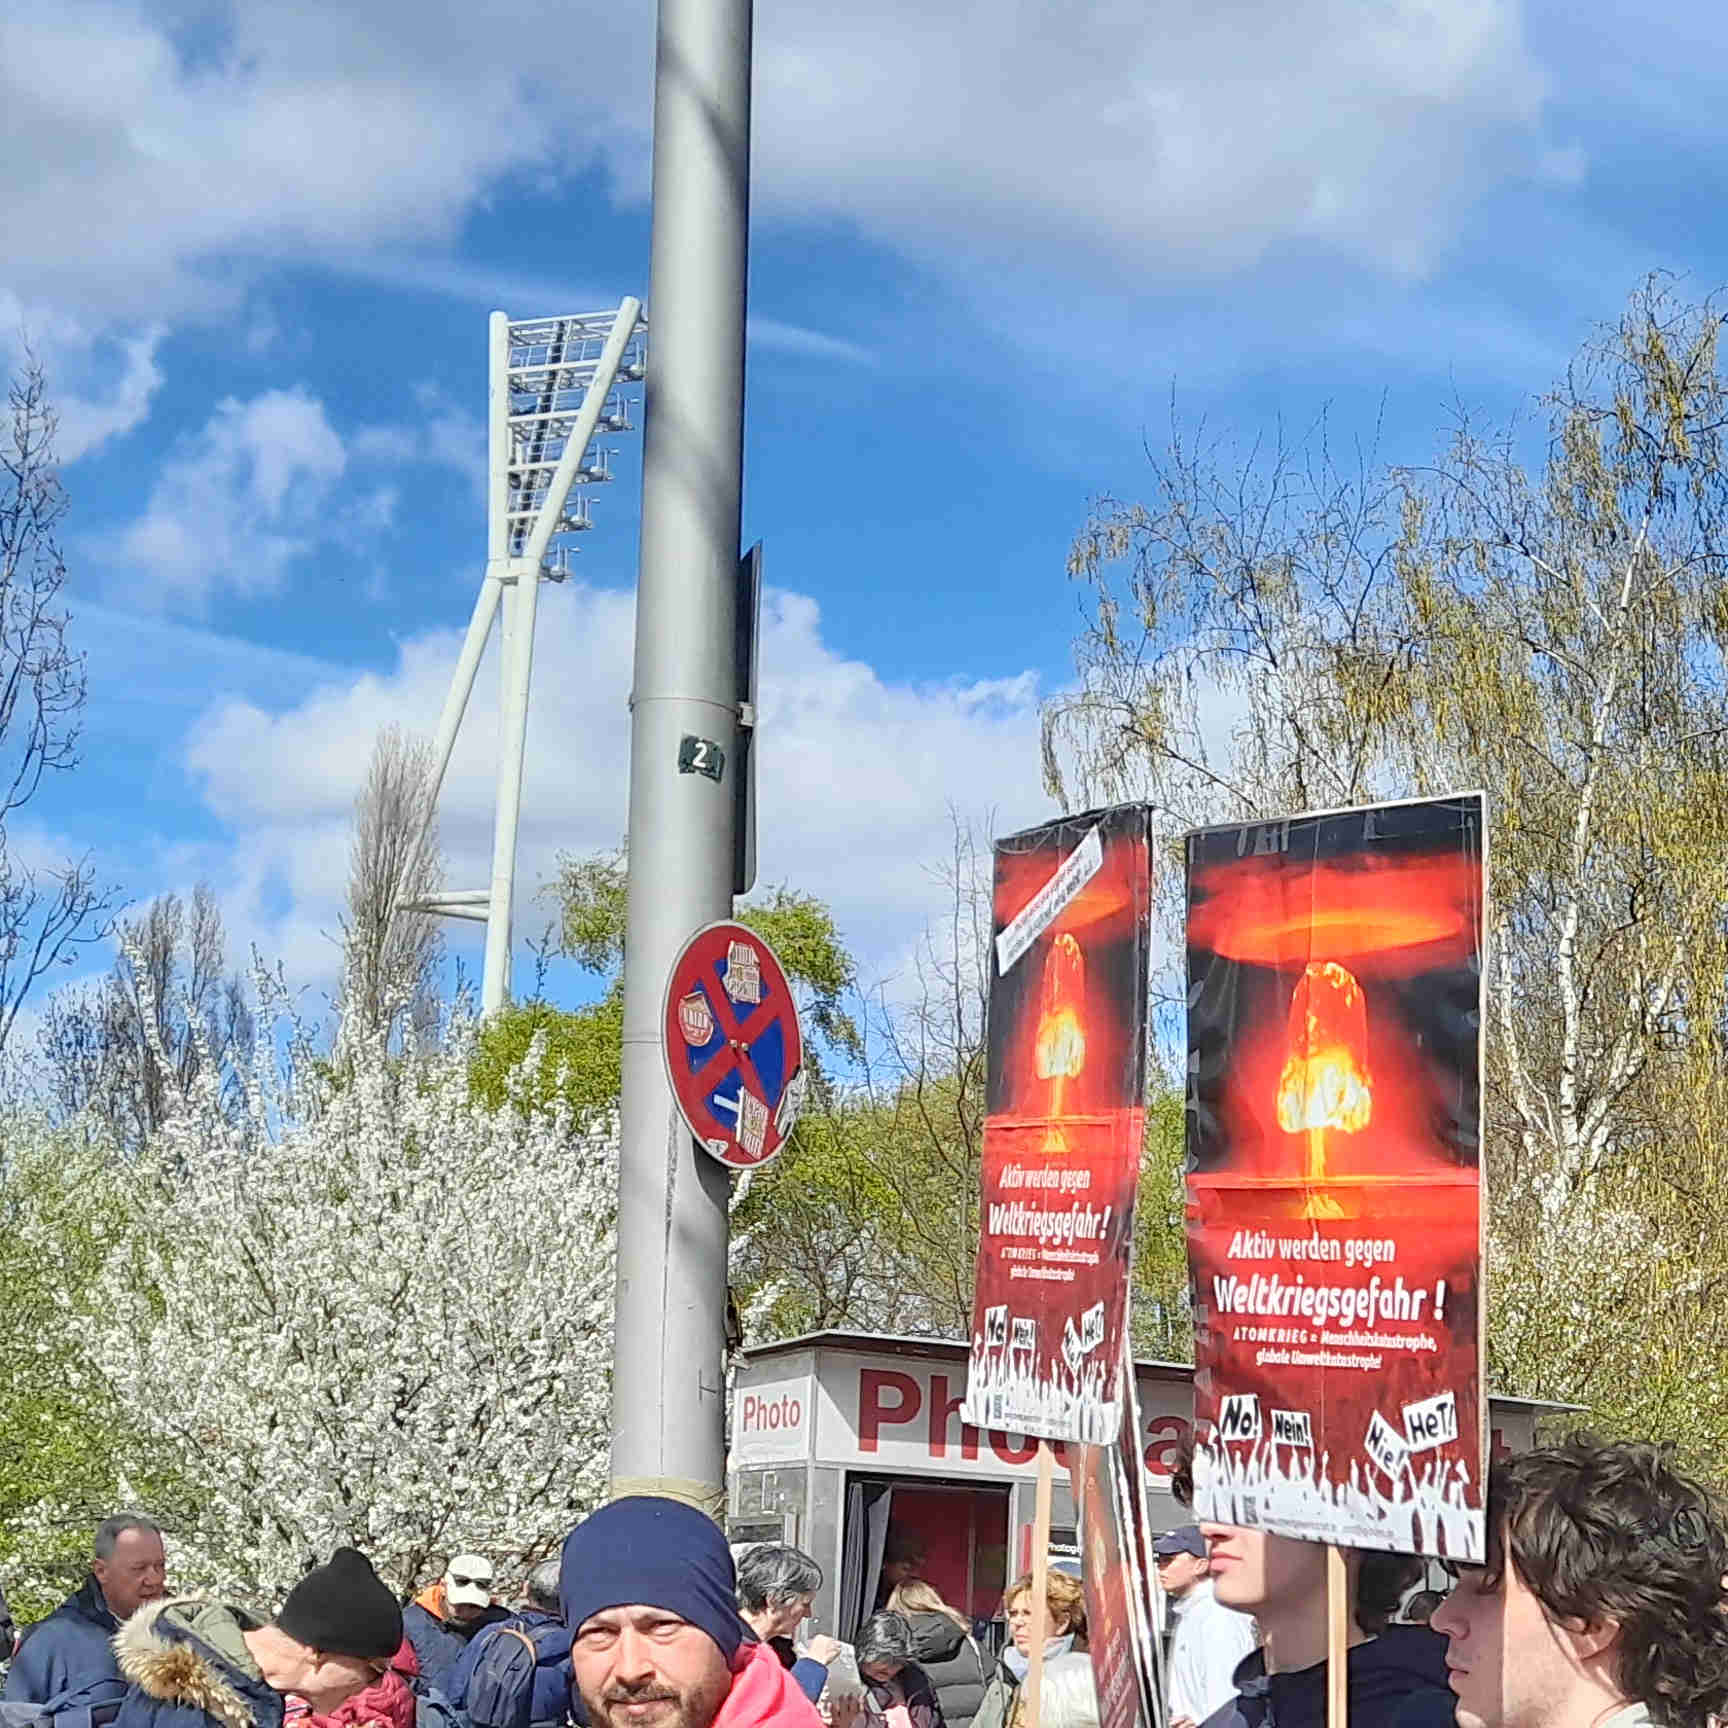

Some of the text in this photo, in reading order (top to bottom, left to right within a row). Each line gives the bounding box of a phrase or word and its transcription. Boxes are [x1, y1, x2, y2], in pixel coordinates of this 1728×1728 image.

[1227, 1229, 1396, 1268] Aktiv werden gegen
[742, 1395, 801, 1433] Photo
[1222, 1397, 1260, 1436] No!
[1274, 1413, 1310, 1444] Nein!
